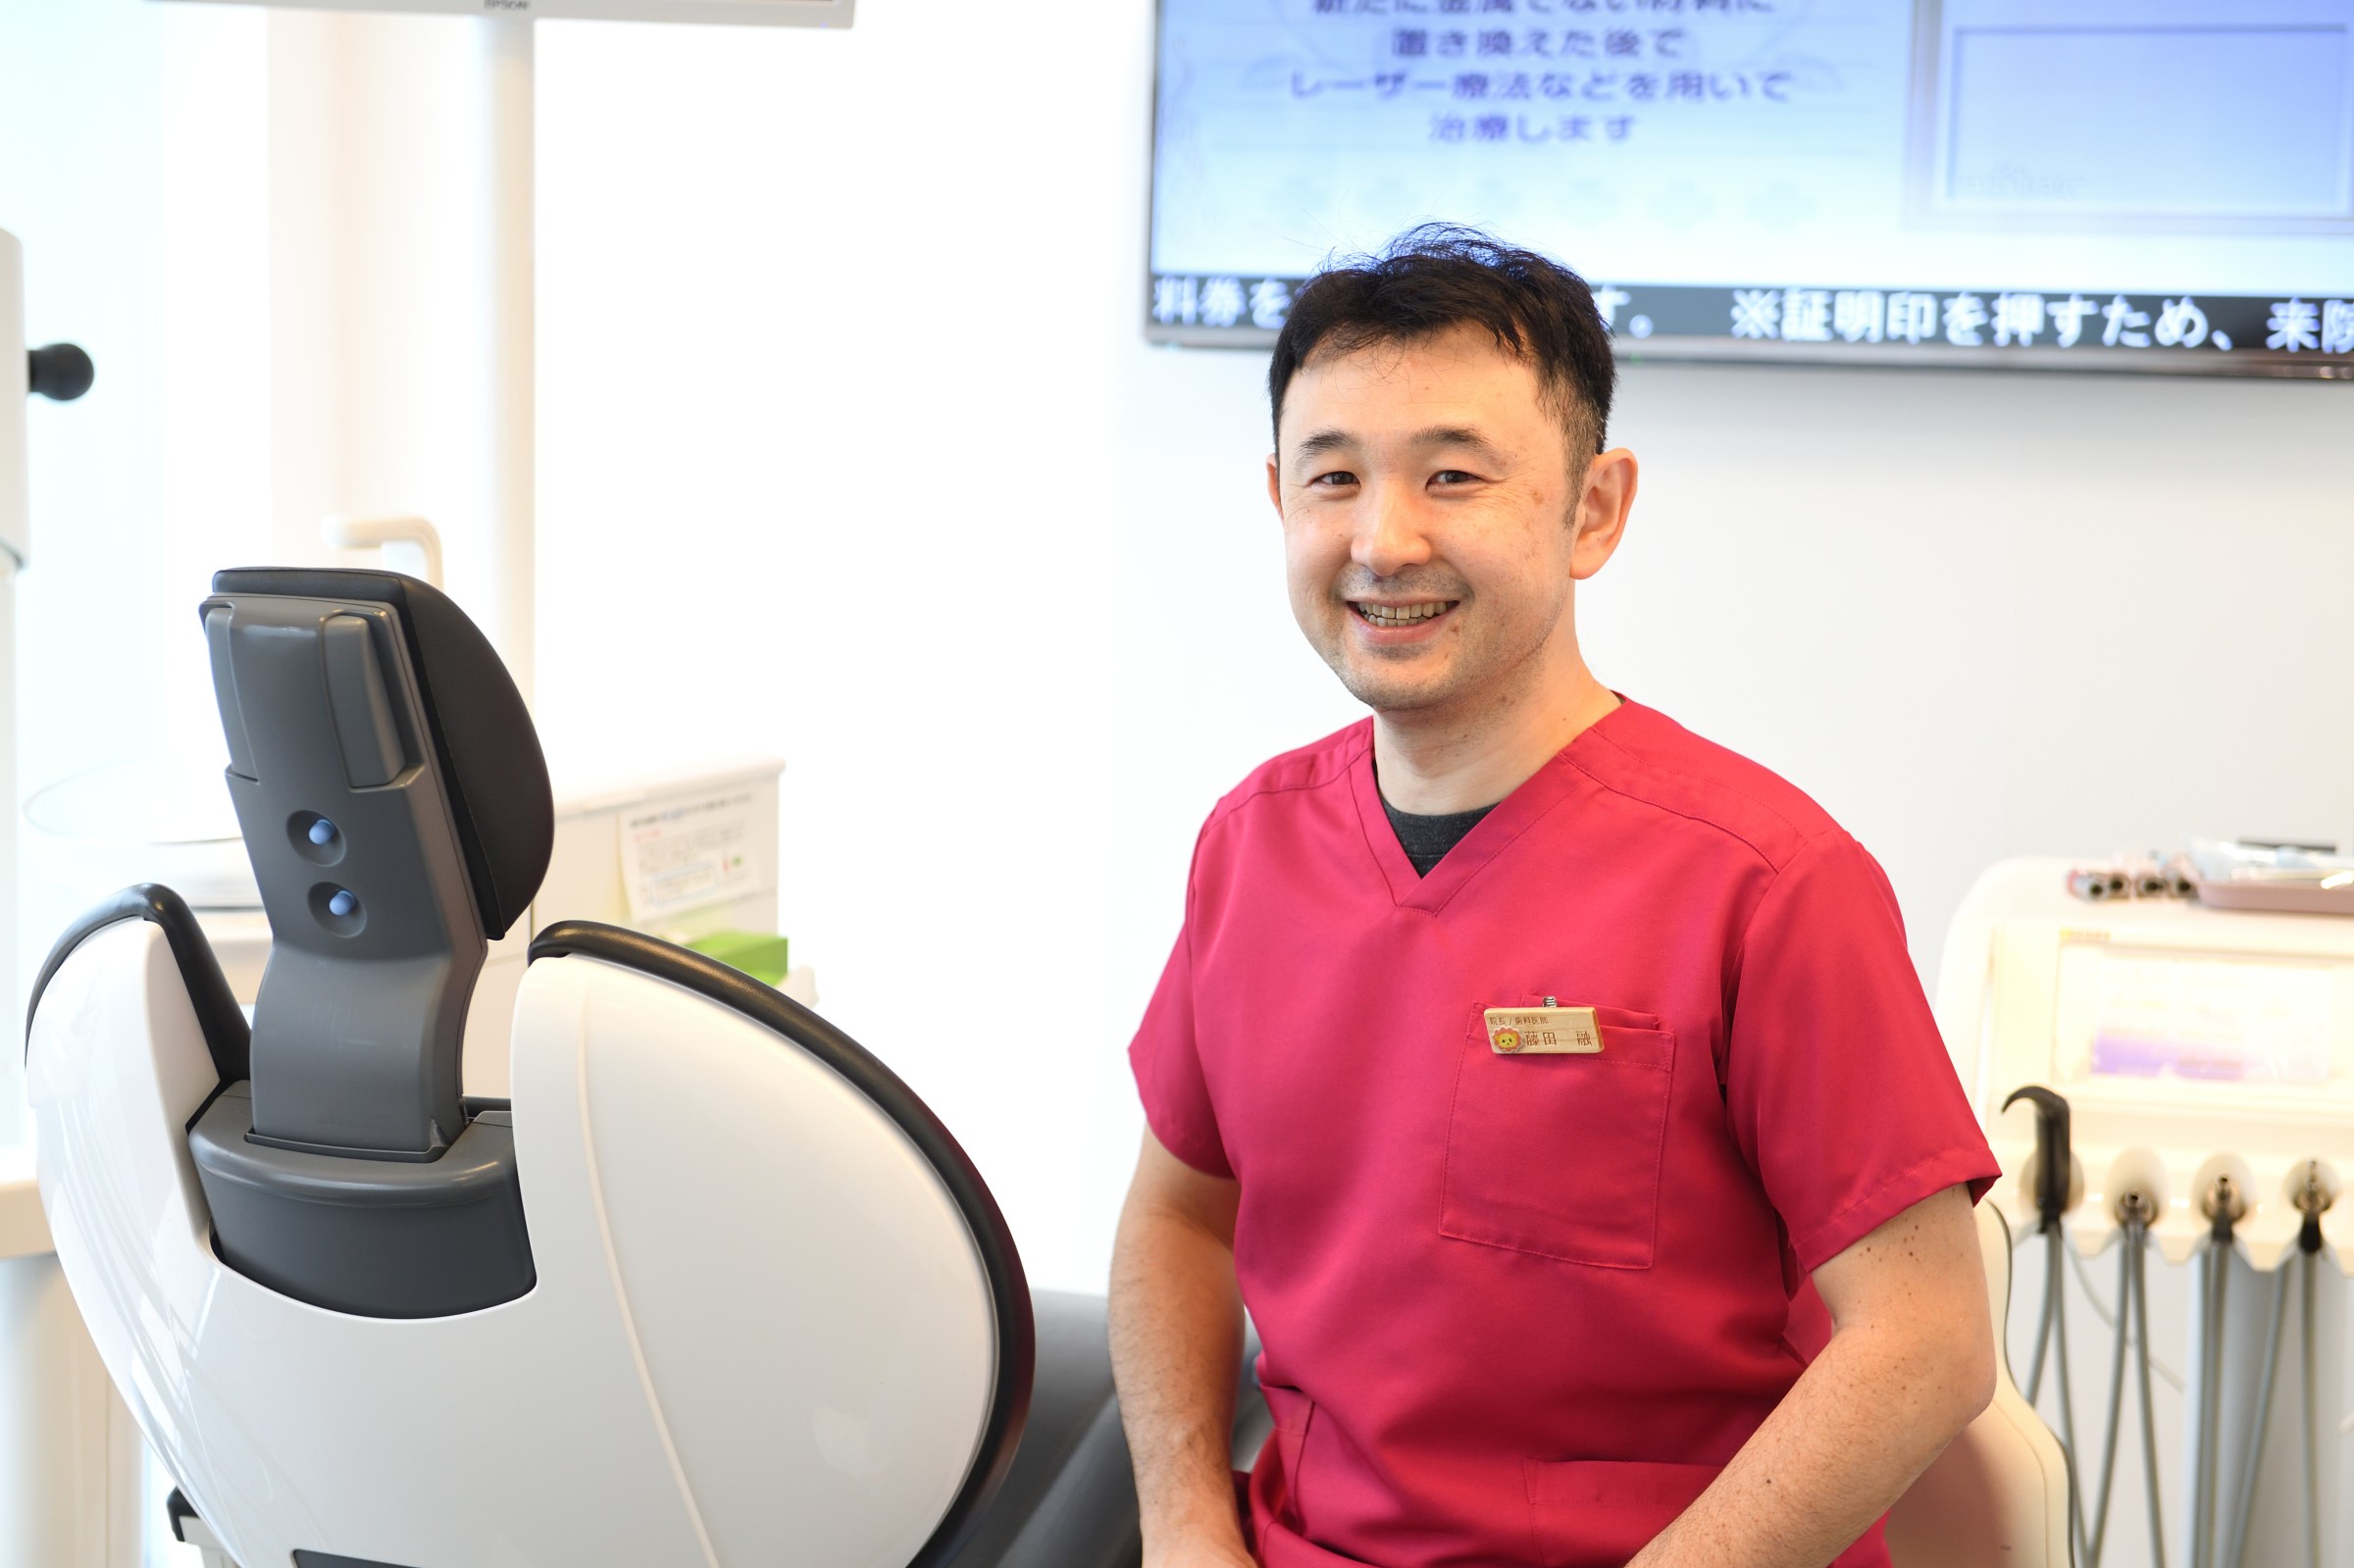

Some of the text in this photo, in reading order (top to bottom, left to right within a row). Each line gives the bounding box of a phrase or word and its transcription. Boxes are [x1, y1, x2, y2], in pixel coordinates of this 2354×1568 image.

[483, 0, 529, 11] EPSON
[1391, 27, 1686, 58] 置き換えた後で
[1290, 70, 1794, 100] レーザー療法などを用いて
[1429, 114, 1636, 143] 治療します
